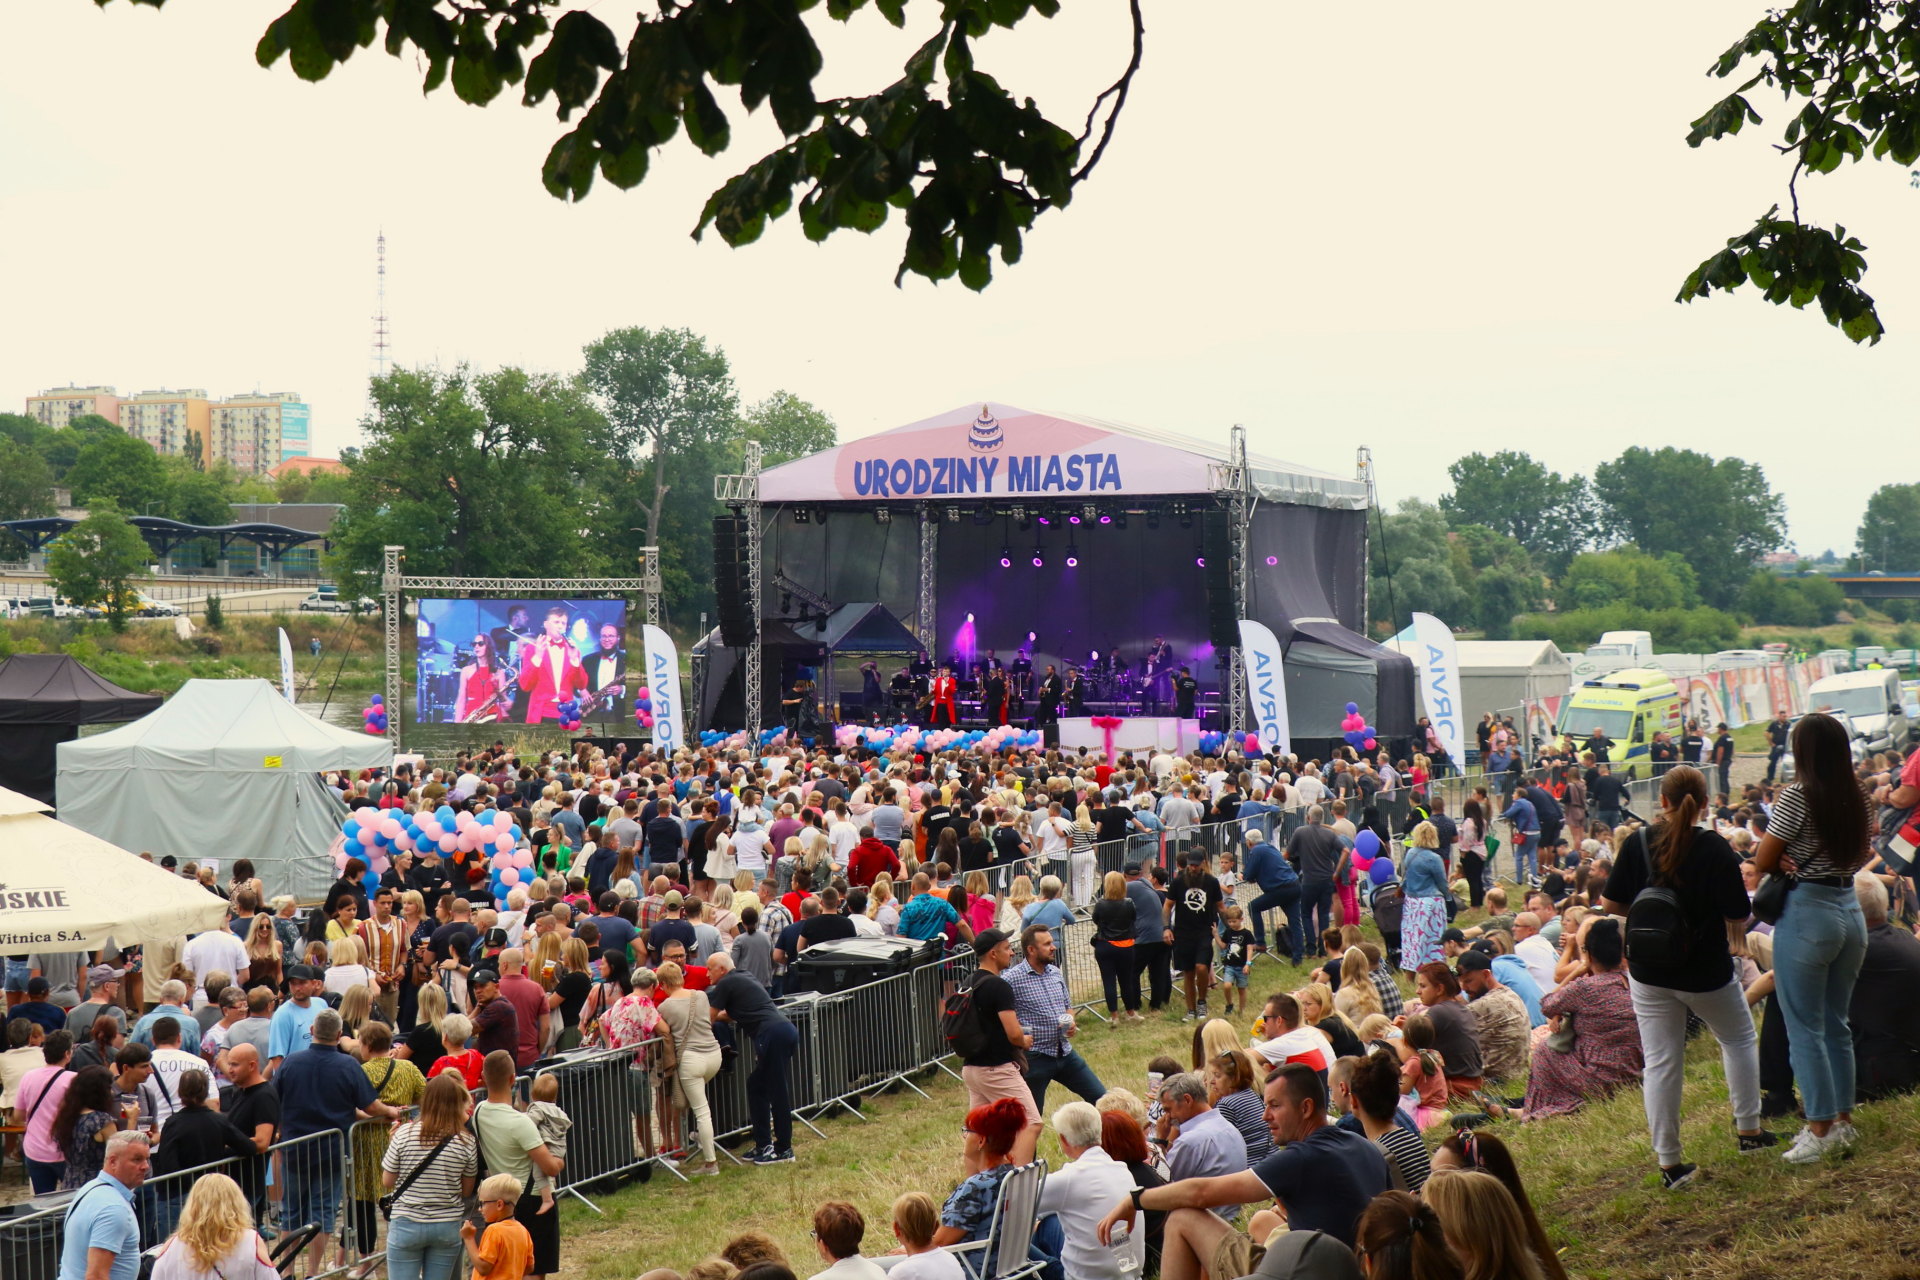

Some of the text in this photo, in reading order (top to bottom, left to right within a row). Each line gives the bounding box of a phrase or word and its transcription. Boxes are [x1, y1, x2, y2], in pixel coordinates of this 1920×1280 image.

[854, 453, 1122, 497] URODZINY MIASTA
[57, 930, 87, 942] S.A.
